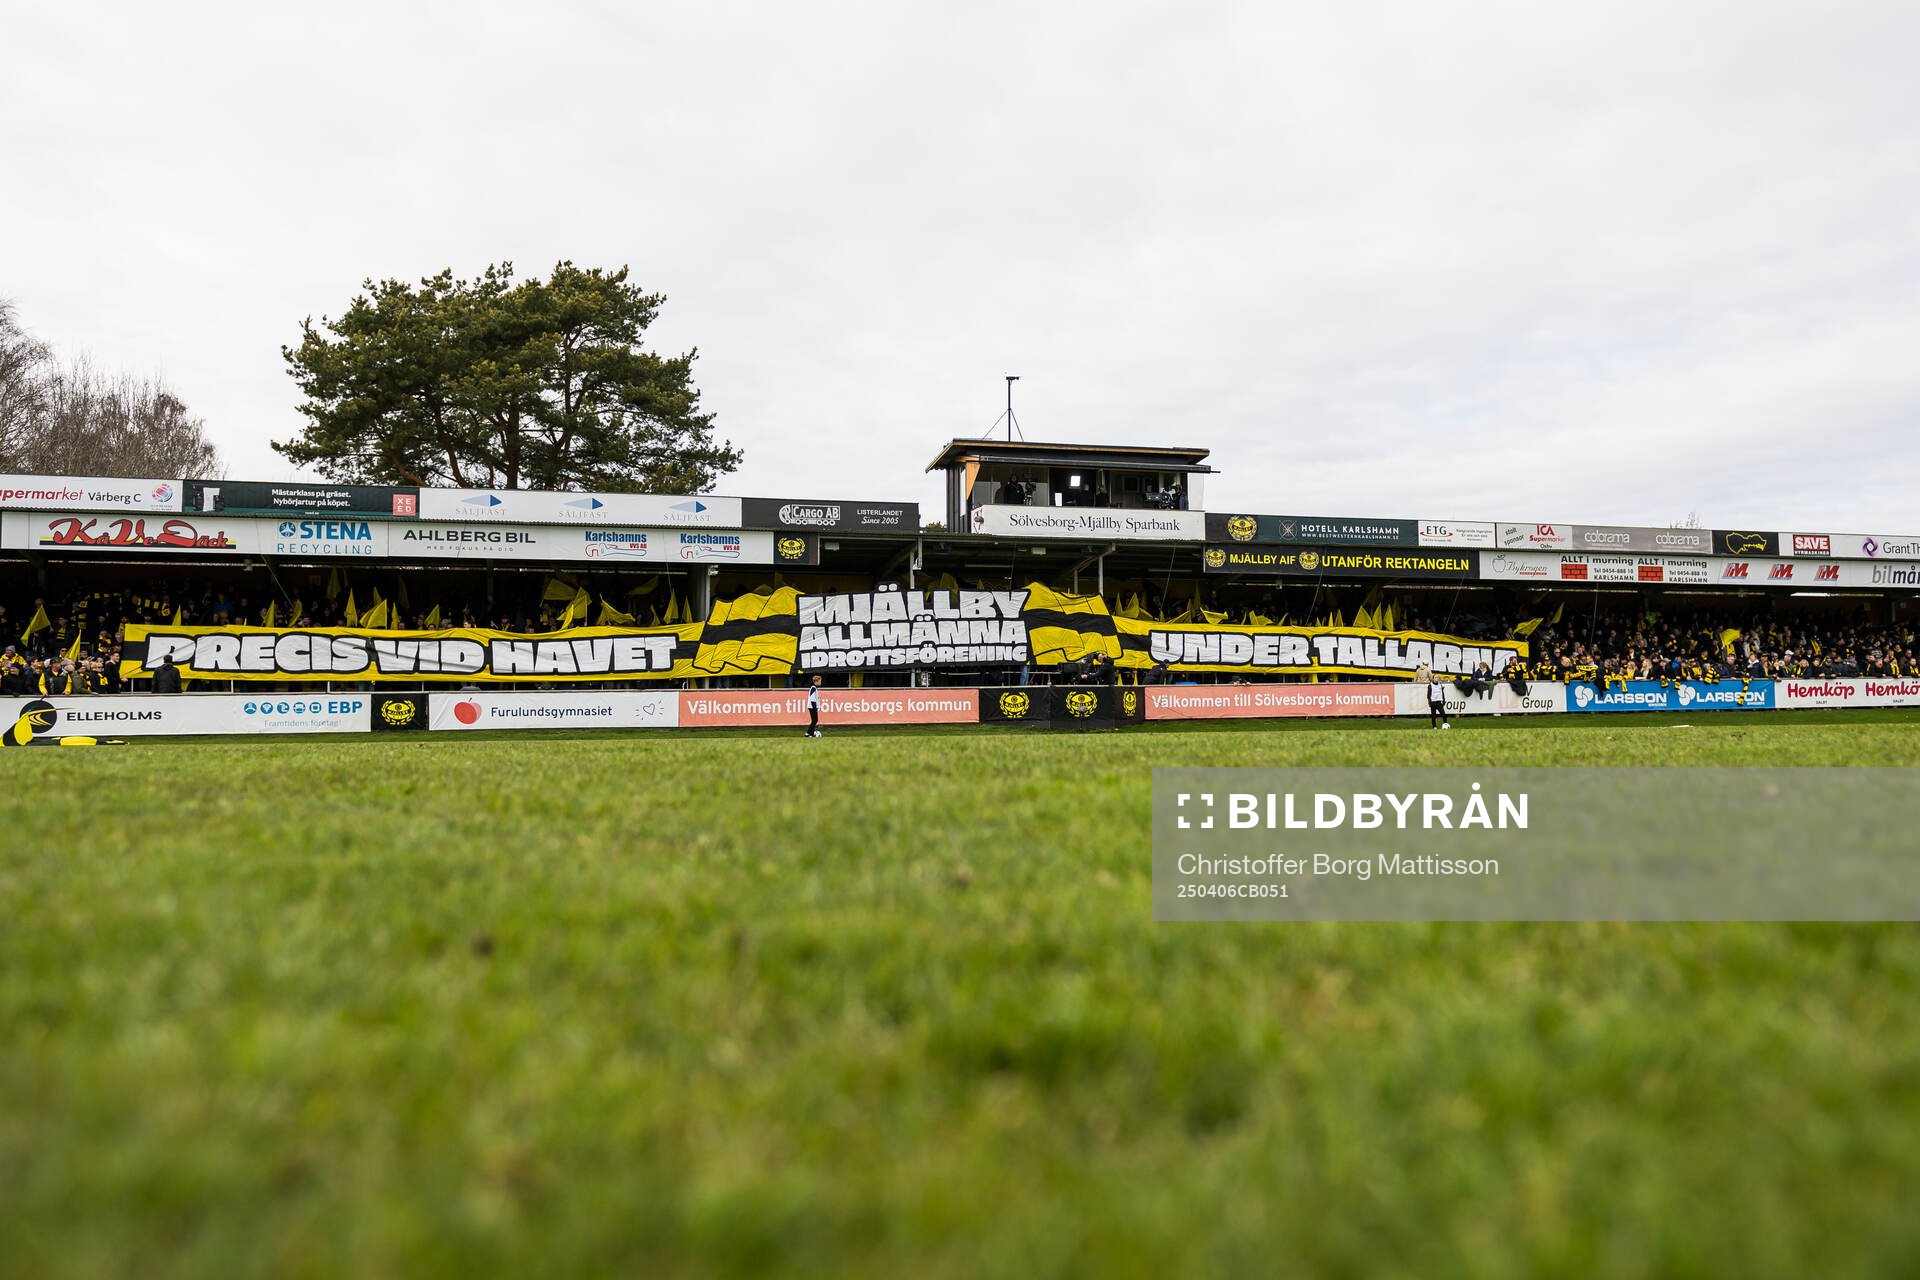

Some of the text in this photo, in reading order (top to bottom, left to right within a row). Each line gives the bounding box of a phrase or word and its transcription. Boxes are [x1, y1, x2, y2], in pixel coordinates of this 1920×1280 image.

[0, 486, 142, 504] permarket Vårberg C
[271, 488, 351, 499] Mästarklass på gräset.
[273, 498, 351, 508] Nybörjartur på köpet.
[825, 507, 839, 519] AB
[857, 509, 903, 517] LISTERLANDET
[861, 516, 899, 525] Since 2005
[1009, 513, 1181, 533] Sölvesborg-Mjällby Sparbank
[300, 521, 372, 541] STENA
[1301, 524, 1399, 535] HOTELL KARLSHAMN
[1426, 525, 1447, 536] ETG
[1536, 524, 1555, 536] ICA
[403, 529, 537, 544] AHLBERG BIL
[585, 531, 647, 543] Karlshamns
[680, 533, 740, 545] Karlshamns
[1503, 534, 1524, 546] sponsor
[1584, 530, 1630, 544] colorama
[1655, 532, 1700, 546] colorama
[1794, 536, 1829, 550] SAVE
[277, 543, 372, 555] RECYCLING
[1229, 552, 1277, 565] MJÄLLBY
[1279, 555, 1297, 565] AIF
[1321, 554, 1470, 571] UTANFÖR REKTANGELN
[1561, 555, 1584, 564] ALLT
[1592, 556, 1634, 566] murning
[1638, 557, 1660, 566] ALLT
[1667, 559, 1708, 569] murning
[798, 583, 1030, 626] MJÄLLBY
[799, 615, 1028, 651] ALLMÄNNA
[144, 633, 679, 675] PRECIS VID HAVET
[1150, 631, 1312, 666] UNDER
[801, 643, 1028, 669] IDROTTSFÖRENING
[1787, 682, 1855, 700] Hemköp
[1151, 692, 1390, 709] Välkommen till Sölvesborgs kommun
[1522, 697, 1553, 711] Group
[1594, 692, 1667, 704] LARSSON
[328, 701, 363, 714] EBP
[490, 705, 613, 719] Furulundsgymnasiet
[687, 697, 972, 715] Välkommen till ölvesborgs kommun
[66, 710, 162, 721] ELLEHOLMS
[264, 719, 309, 728] Framtidens
